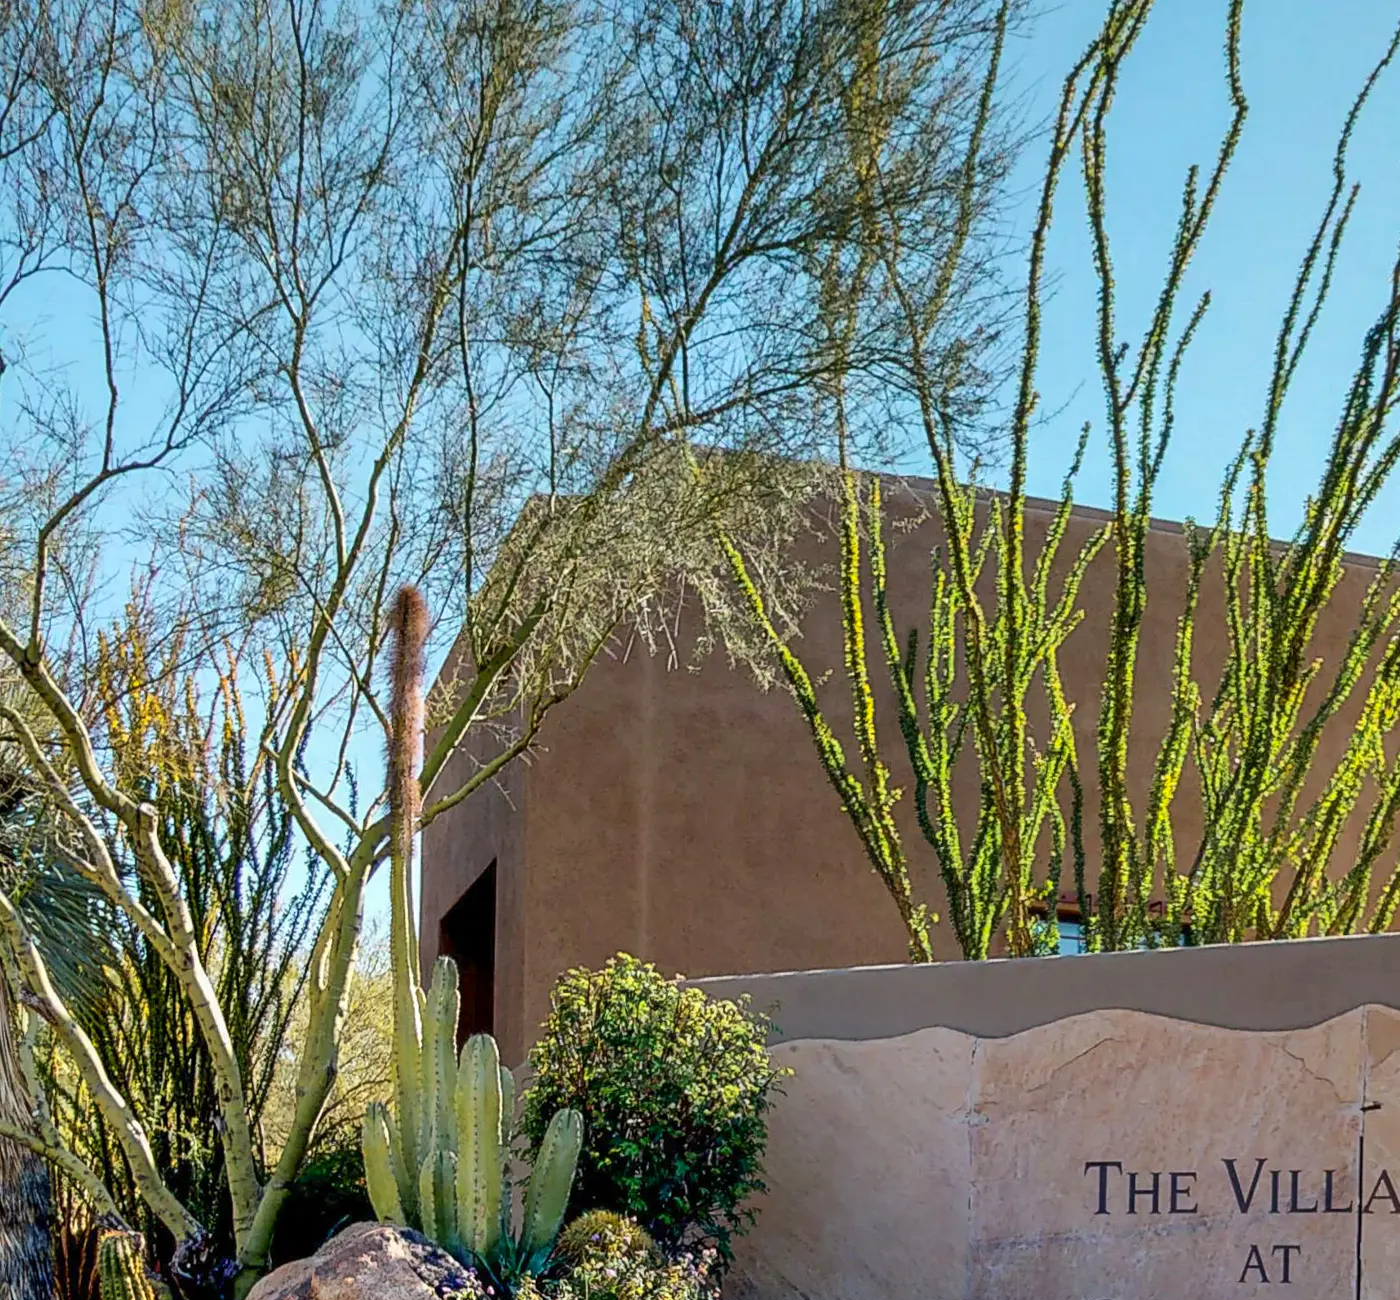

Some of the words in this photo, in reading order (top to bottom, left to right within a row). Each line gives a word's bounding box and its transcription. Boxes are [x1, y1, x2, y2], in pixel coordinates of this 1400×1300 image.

[1084, 1161, 1198, 1215] THE
[1221, 1158, 1400, 1214] VILLA
[1237, 1244, 1301, 1284] AT
